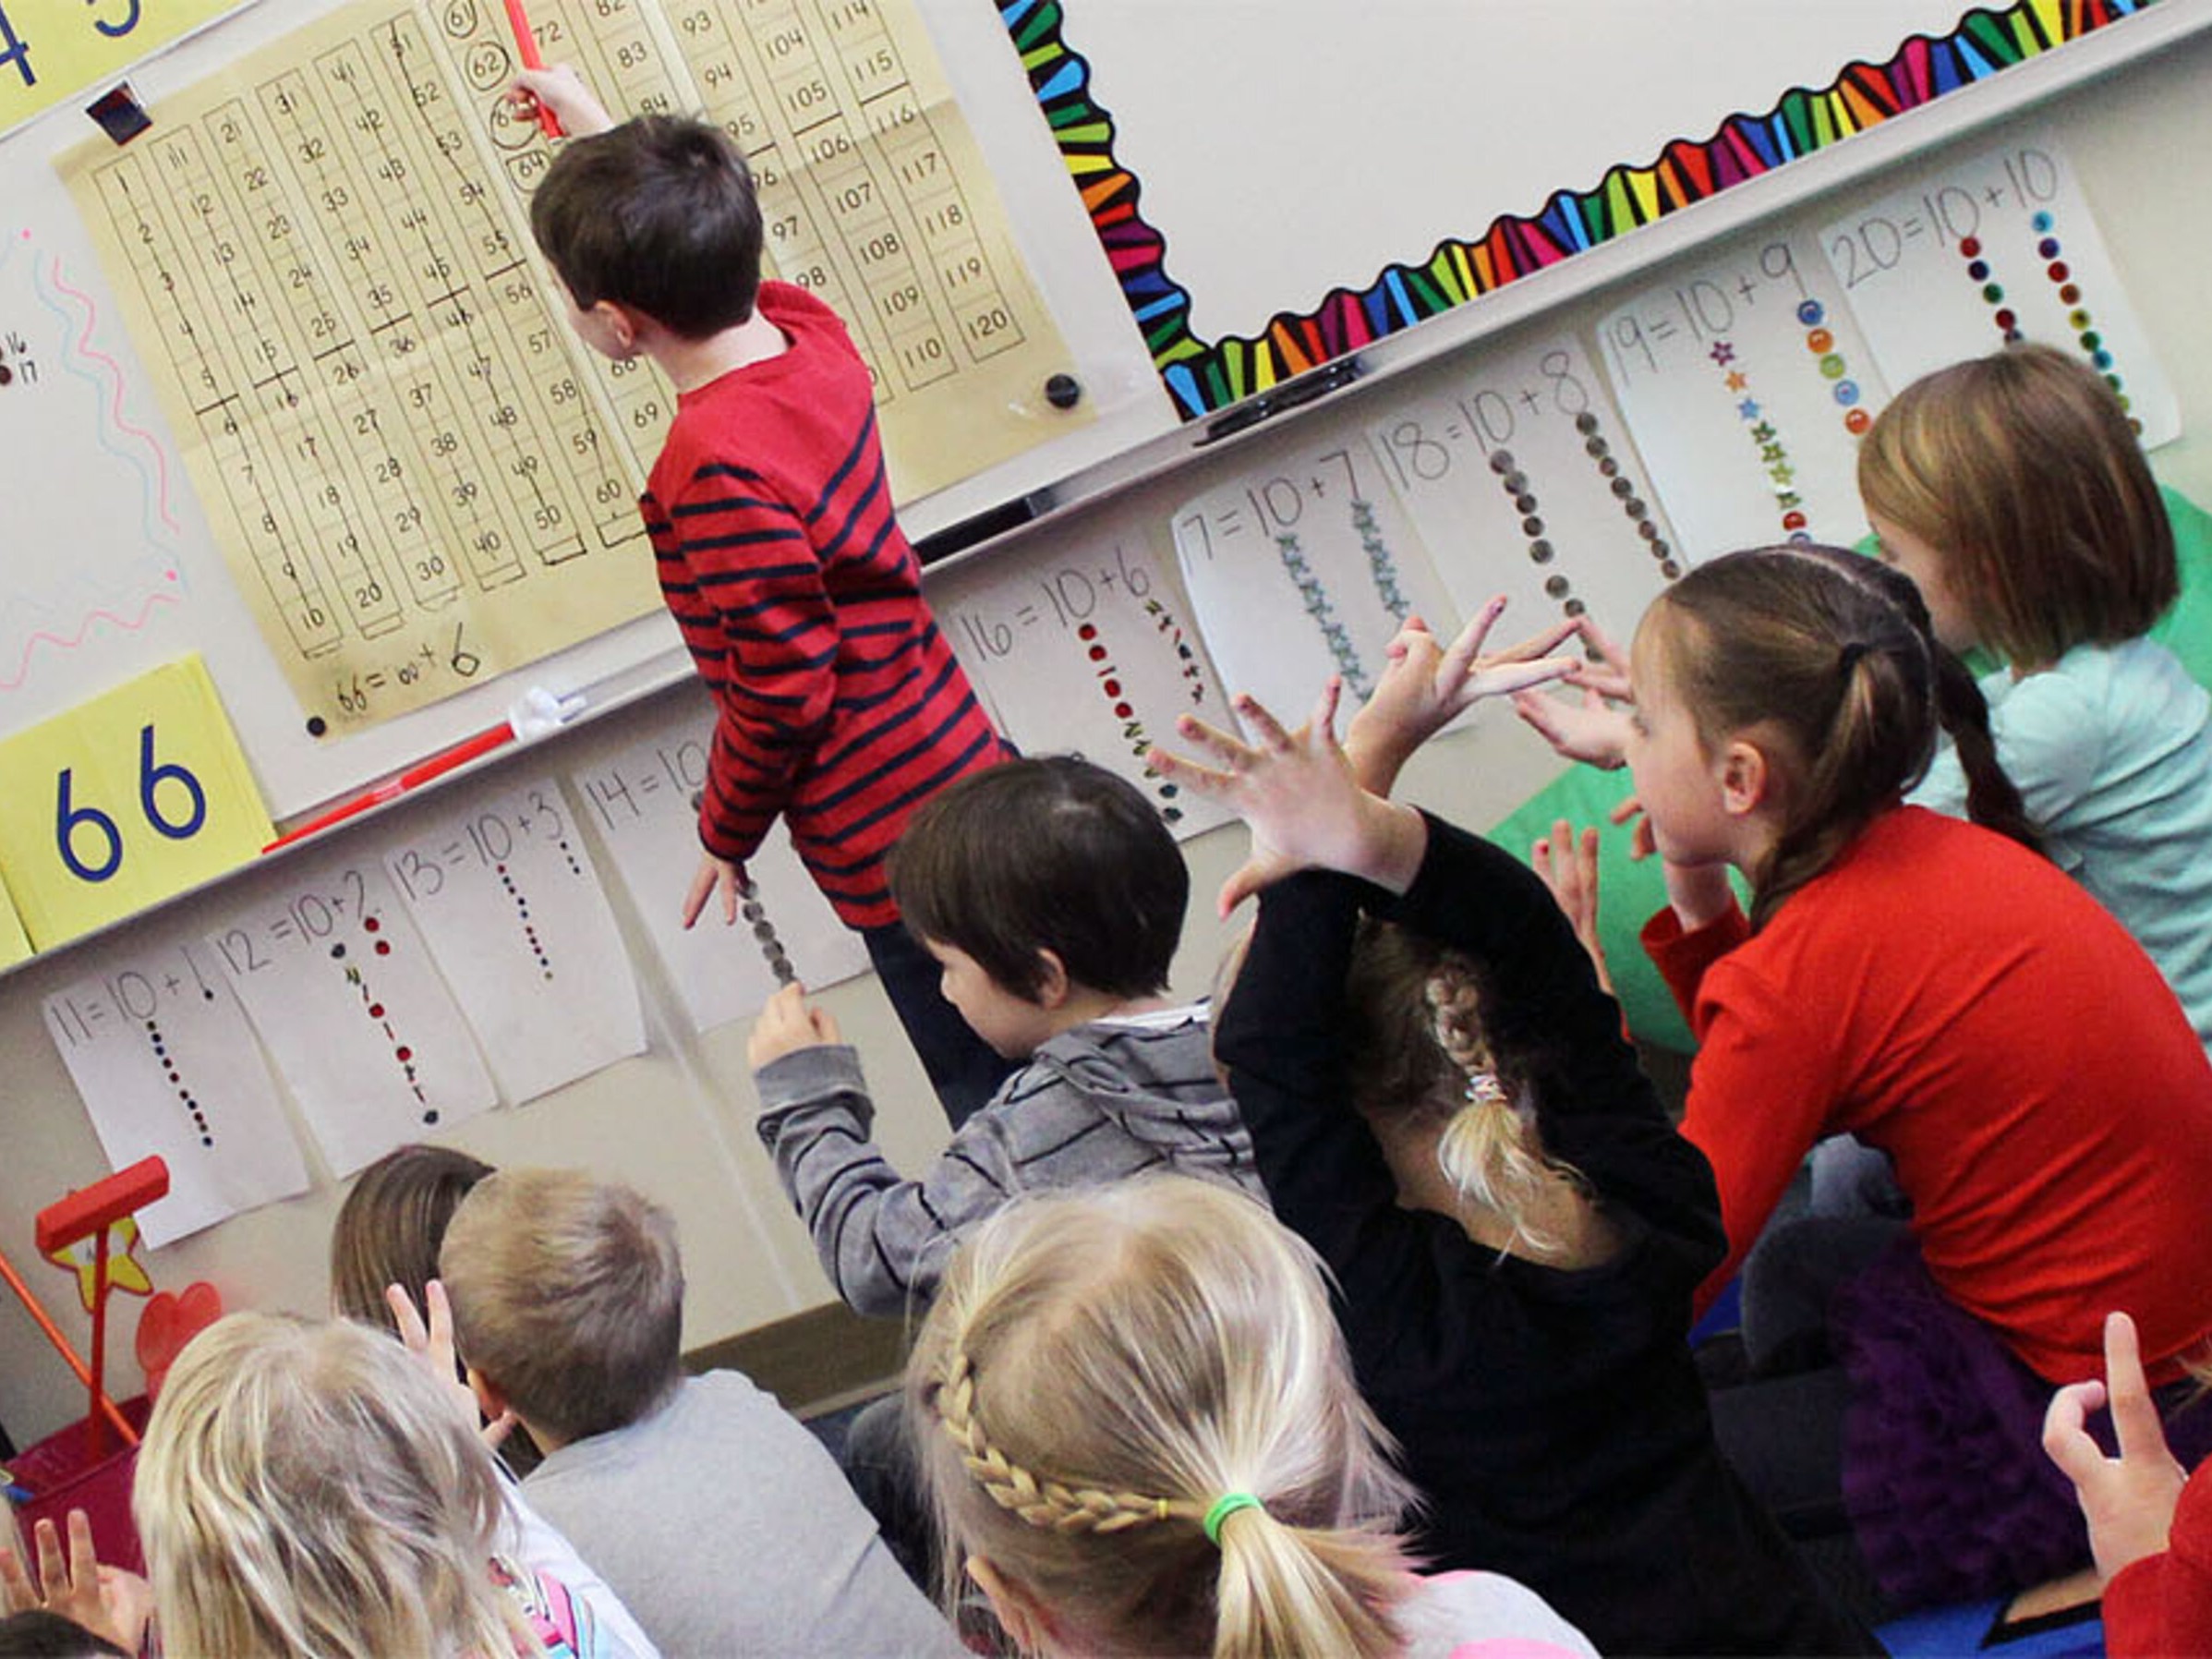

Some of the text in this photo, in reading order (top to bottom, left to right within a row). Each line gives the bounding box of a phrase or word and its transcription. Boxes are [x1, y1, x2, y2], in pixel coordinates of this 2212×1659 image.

[451, 3, 471, 27] 61
[683, 10, 712, 37] 93
[832, 0, 869, 30] 114
[533, 20, 562, 48] 72
[766, 30, 804, 60] 104
[474, 51, 500, 78] 62
[619, 41, 647, 68] 83
[855, 49, 893, 82] 115
[332, 57, 357, 82] 41
[705, 64, 732, 89] 94
[275, 91, 298, 115] 31
[412, 81, 440, 109] 52
[788, 81, 827, 113] 105
[221, 120, 242, 143] 21
[355, 108, 382, 133] 42
[728, 113, 755, 139] 95
[876, 103, 914, 134] 116
[298, 137, 325, 163] 32
[435, 130, 463, 157] 53
[810, 134, 850, 164] 106
[378, 157, 405, 182] 43
[518, 151, 545, 178] 64
[902, 151, 937, 185] 117
[244, 166, 268, 192] 22
[189, 193, 213, 219] 12
[321, 187, 348, 212] 33
[460, 183, 486, 206] 54
[836, 182, 872, 213] 107
[268, 214, 291, 240] 23
[401, 209, 429, 229] 44
[772, 215, 798, 239] 97
[925, 204, 963, 236] 118
[139, 223, 153, 245] 2
[481, 230, 509, 256] 55
[212, 241, 235, 266] 13
[344, 236, 371, 260] 34
[860, 233, 900, 264] 108
[288, 265, 312, 288] 24
[424, 257, 451, 282] 45
[796, 266, 827, 288] 98
[946, 257, 982, 287] 119
[368, 284, 393, 309] 35
[504, 283, 533, 305] 56
[884, 285, 919, 317] 109
[311, 311, 336, 338] 25
[445, 308, 474, 328] 46
[966, 309, 1009, 343] 120
[254, 338, 277, 364] 15
[389, 336, 417, 359] 36
[528, 329, 551, 354] 57
[905, 337, 942, 369] 110
[201, 368, 215, 389] 5
[333, 363, 359, 386] 26
[466, 355, 491, 378] 47
[409, 382, 432, 409] 37
[550, 379, 576, 405] 58
[224, 415, 238, 435] 6
[353, 408, 377, 434] 27
[489, 405, 518, 429] 48
[635, 401, 657, 428] 69
[297, 436, 317, 462] 17
[430, 432, 458, 457] 38
[572, 429, 598, 455] 59
[241, 464, 254, 485] 7
[375, 457, 402, 483] 28
[511, 454, 538, 478] 49
[318, 485, 340, 510] 18
[453, 481, 477, 507] 39
[596, 478, 622, 503] 60
[262, 513, 277, 533] 8
[394, 506, 422, 533] 29
[535, 504, 562, 530] 50
[336, 535, 359, 559] 19
[472, 530, 502, 554] 40
[283, 563, 296, 580] 9
[417, 555, 444, 582] 30
[356, 581, 382, 609] 20
[302, 608, 325, 630] 10
[57, 724, 206, 882] 66
